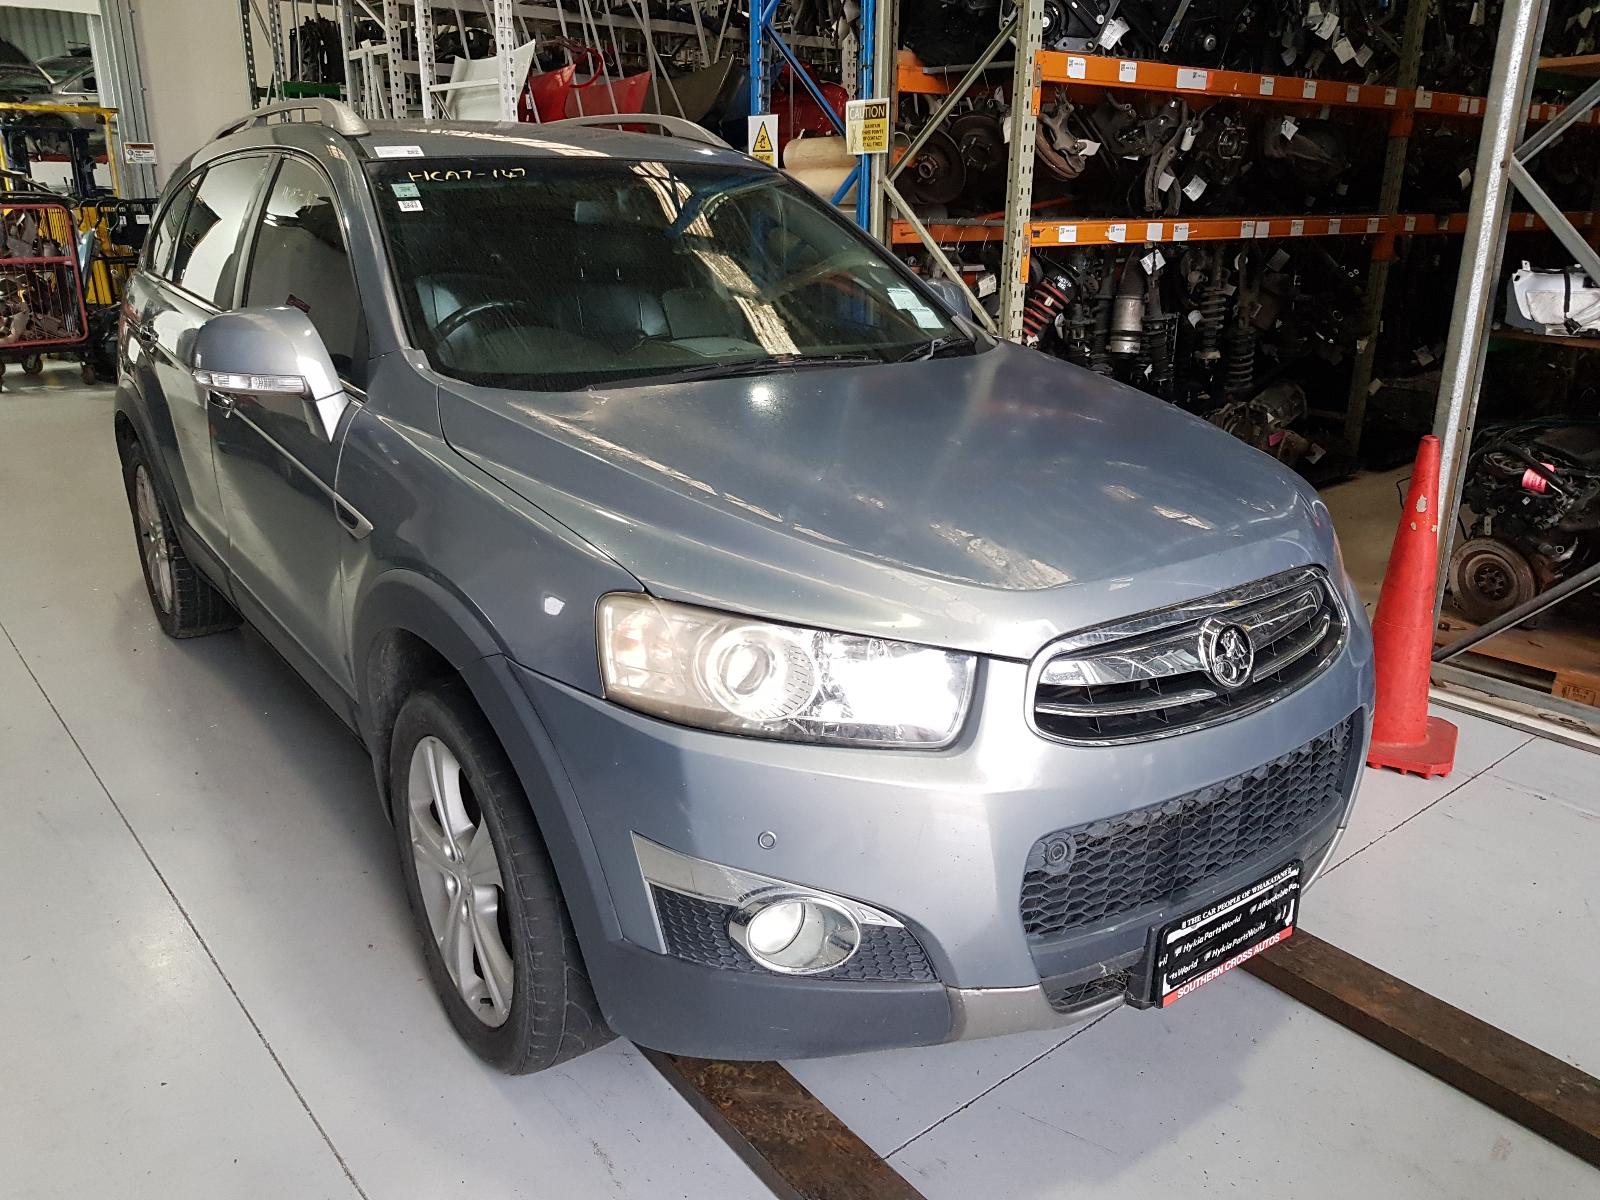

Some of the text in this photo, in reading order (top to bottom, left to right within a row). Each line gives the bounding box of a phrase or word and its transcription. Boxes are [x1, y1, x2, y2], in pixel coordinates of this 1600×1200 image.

[849, 105, 886, 120] CAUTION
[1187, 914, 1202, 926] THE
[1203, 907, 1216, 919] CAR
[1217, 895, 1241, 912] PEOPLE
[1242, 889, 1251, 899] OF
[1177, 932, 1281, 999] SOUTHERN CROSS AUTOS
